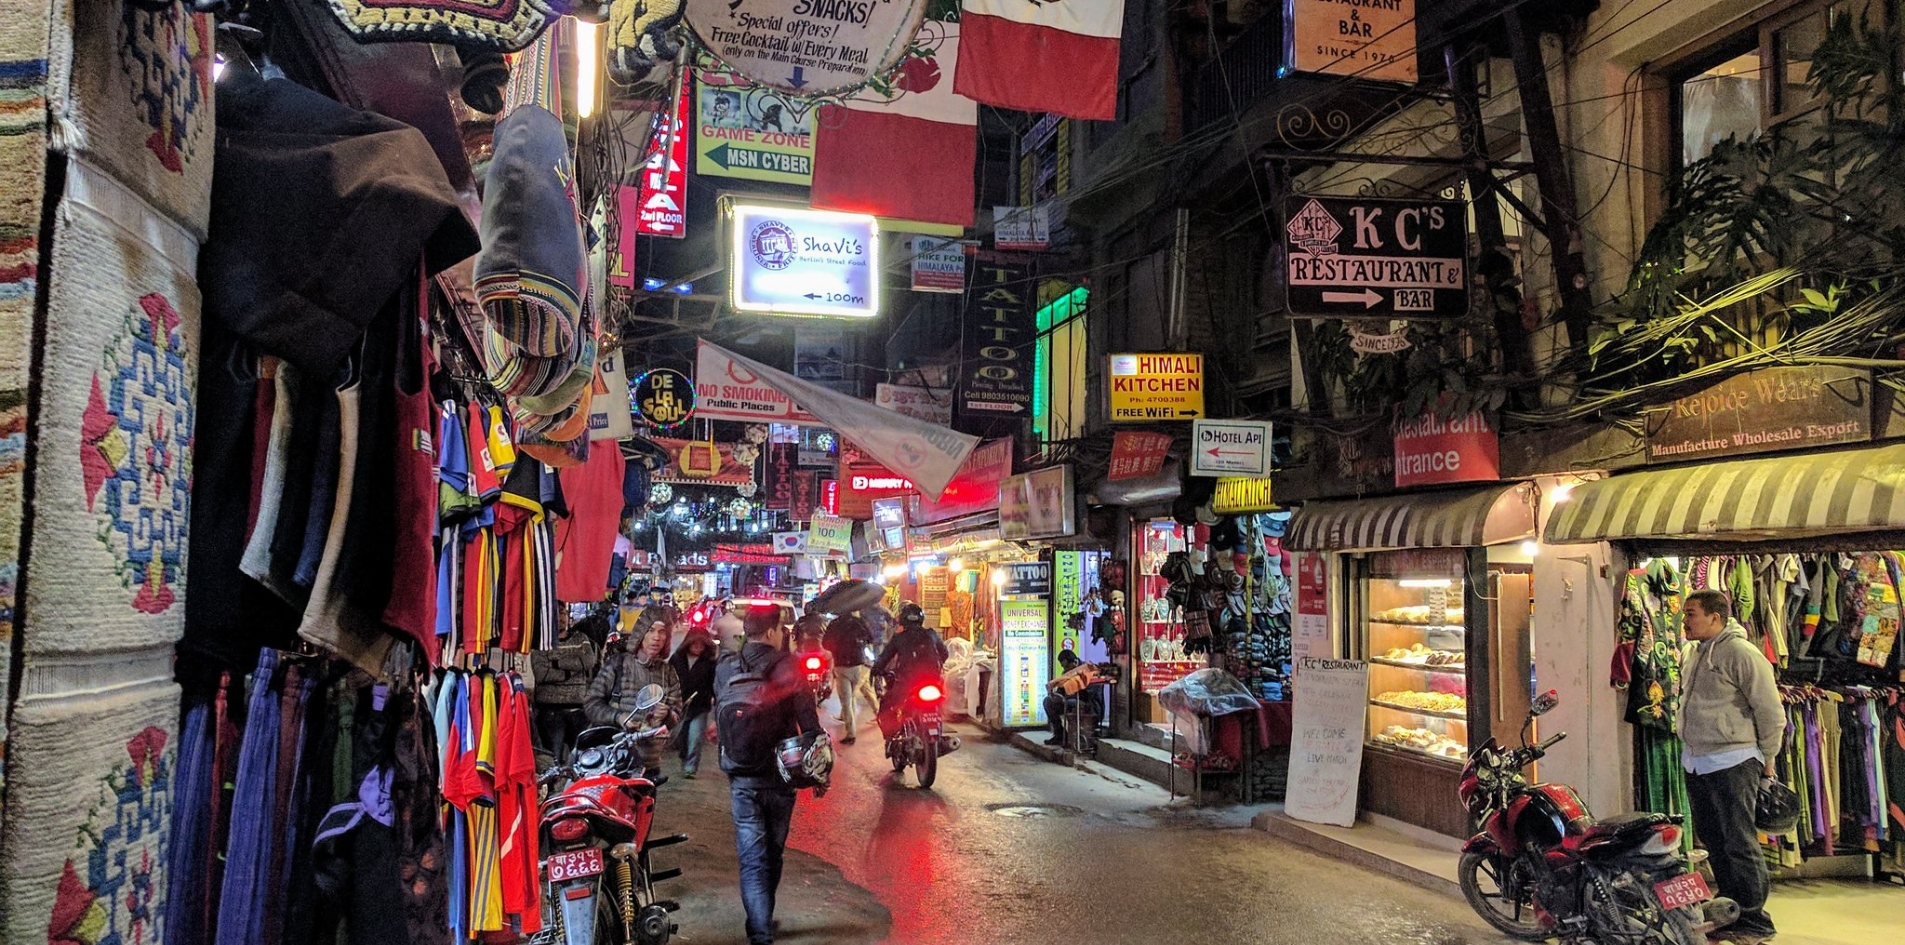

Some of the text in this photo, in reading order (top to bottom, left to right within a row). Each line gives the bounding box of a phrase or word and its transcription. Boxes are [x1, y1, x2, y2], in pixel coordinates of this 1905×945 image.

[793, 0, 876, 29] SNACKS!
[1350, 9, 1360, 21] &
[737, 12, 840, 43] Special offers!
[1339, 20, 1373, 38] BAR
[711, 26, 739, 44] Free
[741, 30, 790, 52] Cocktail
[805, 41, 837, 60] Every
[839, 47, 869, 64] Meal
[1317, 45, 1356, 59] SINCE
[722, 44, 742, 57] (only
[744, 49, 755, 58] on
[757, 49, 770, 59] the
[771, 51, 790, 64] Main
[790, 55, 817, 68] Course
[701, 124, 811, 149] GAME ZONE
[727, 149, 810, 174] MSN CYBER
[656, 212, 683, 224] FLOOR
[847, 259, 867, 267] Food
[917, 253, 965, 263] HIKE FOR
[917, 261, 954, 271] HIMALAYA
[1291, 257, 1460, 284] RESTAURANT &
[825, 292, 865, 304] 100m
[1396, 290, 1433, 309] BAR
[979, 267, 1022, 380] TATTOO
[1355, 335, 1386, 351] SINCE
[1139, 356, 1201, 374] HIMALI
[651, 374, 673, 389] DE
[1114, 378, 1201, 393] KITCHEN
[655, 391, 674, 406] LA
[698, 383, 719, 398] NO
[722, 386, 787, 404] SMOKING
[964, 390, 980, 399] Cell
[643, 397, 687, 421] SOUL
[706, 398, 775, 412] Public Places
[984, 403, 1013, 411] FLOOR
[1116, 407, 1175, 418] FREE WiFi
[1674, 384, 1749, 428] Rejoice
[1651, 419, 1860, 457] Manufacture Wholesale Export
[1215, 480, 1241, 509] HIMALI
[818, 527, 836, 538] 100
[1006, 608, 1043, 617] UNIVERSAL
[1322, 660, 1364, 671] RESTAURANT
[1307, 751, 1324, 763] LIVE
[551, 859, 600, 879] ७६६६
